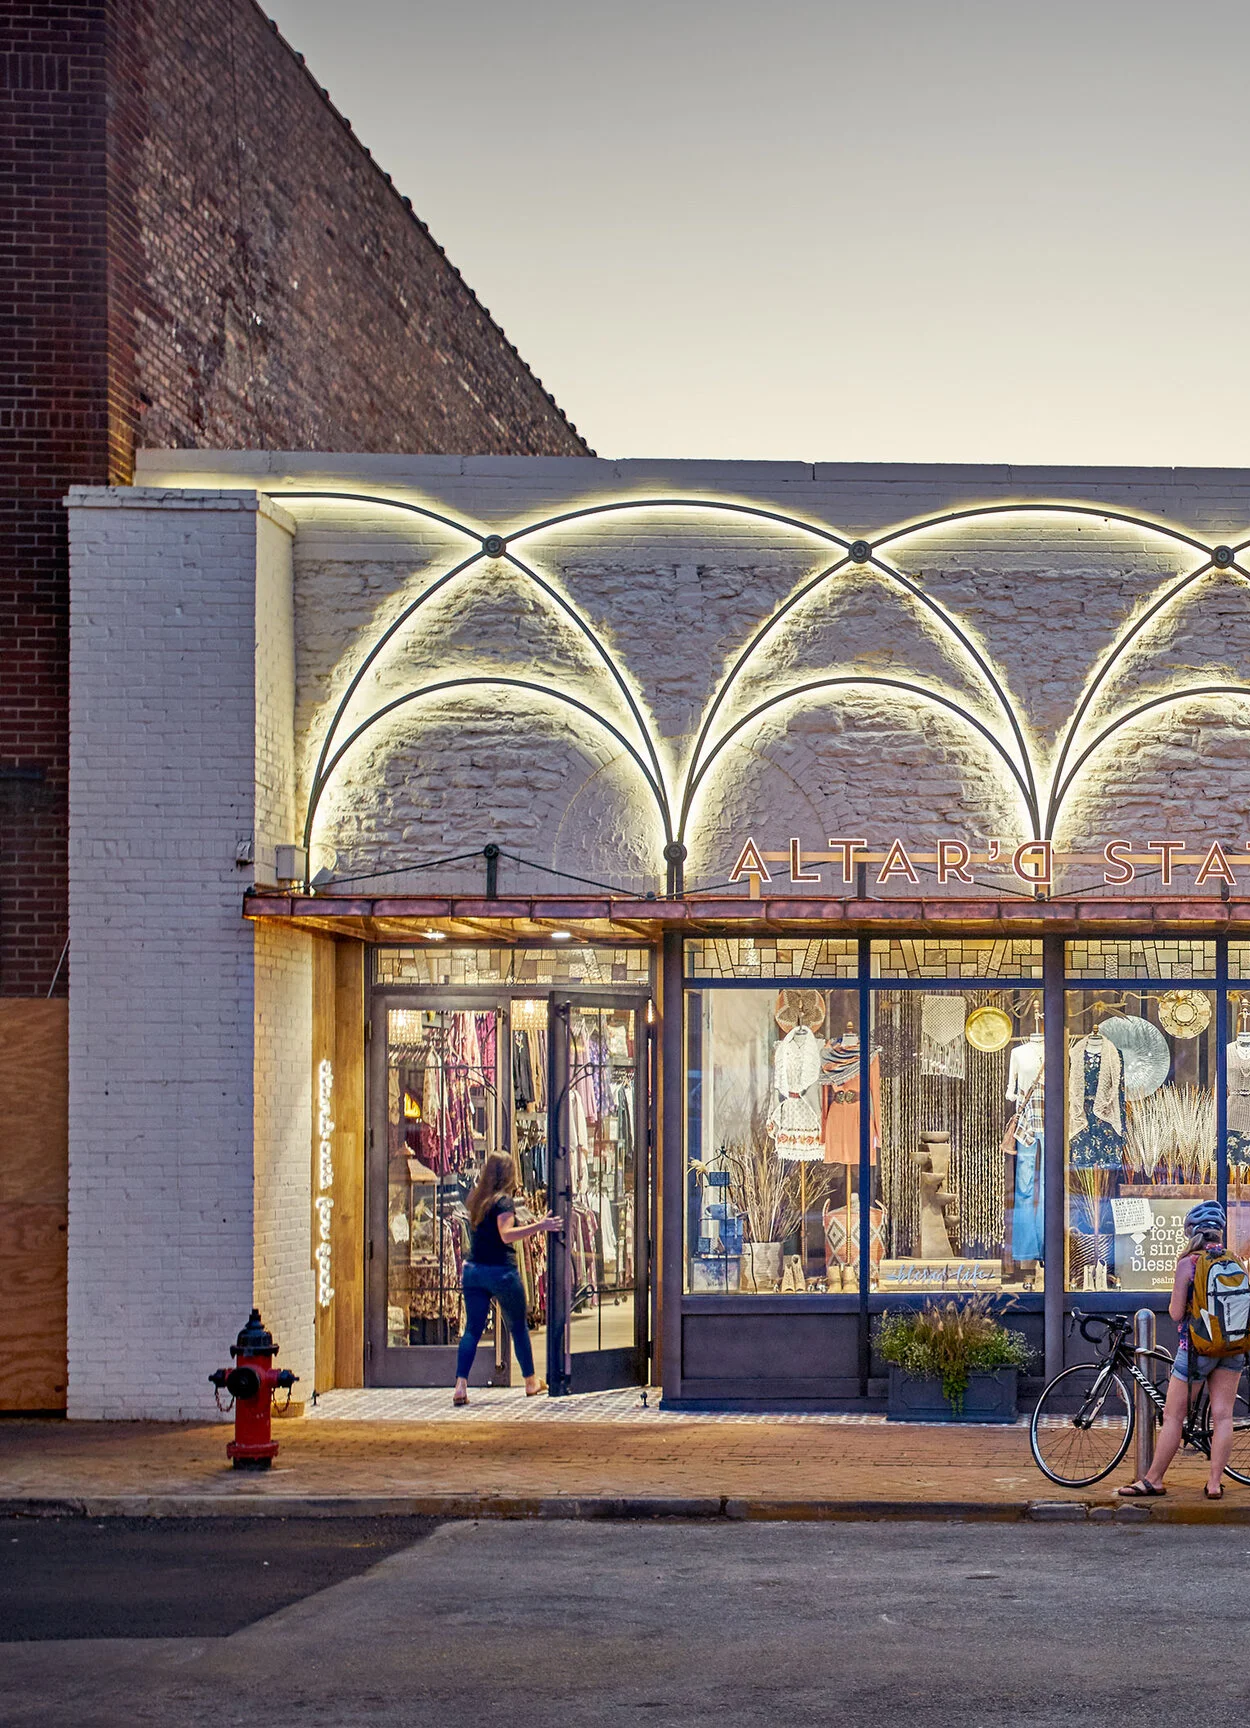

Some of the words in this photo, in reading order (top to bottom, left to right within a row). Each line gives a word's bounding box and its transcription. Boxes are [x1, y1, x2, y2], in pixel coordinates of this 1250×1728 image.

[728, 837, 1053, 885] ALTAR'D
[1134, 1244, 1145, 1256] a
[1130, 1257, 1178, 1272] blessi
[1152, 1276, 1175, 1286] psalm
[1127, 1366, 1166, 1411] SPECIALIZ
